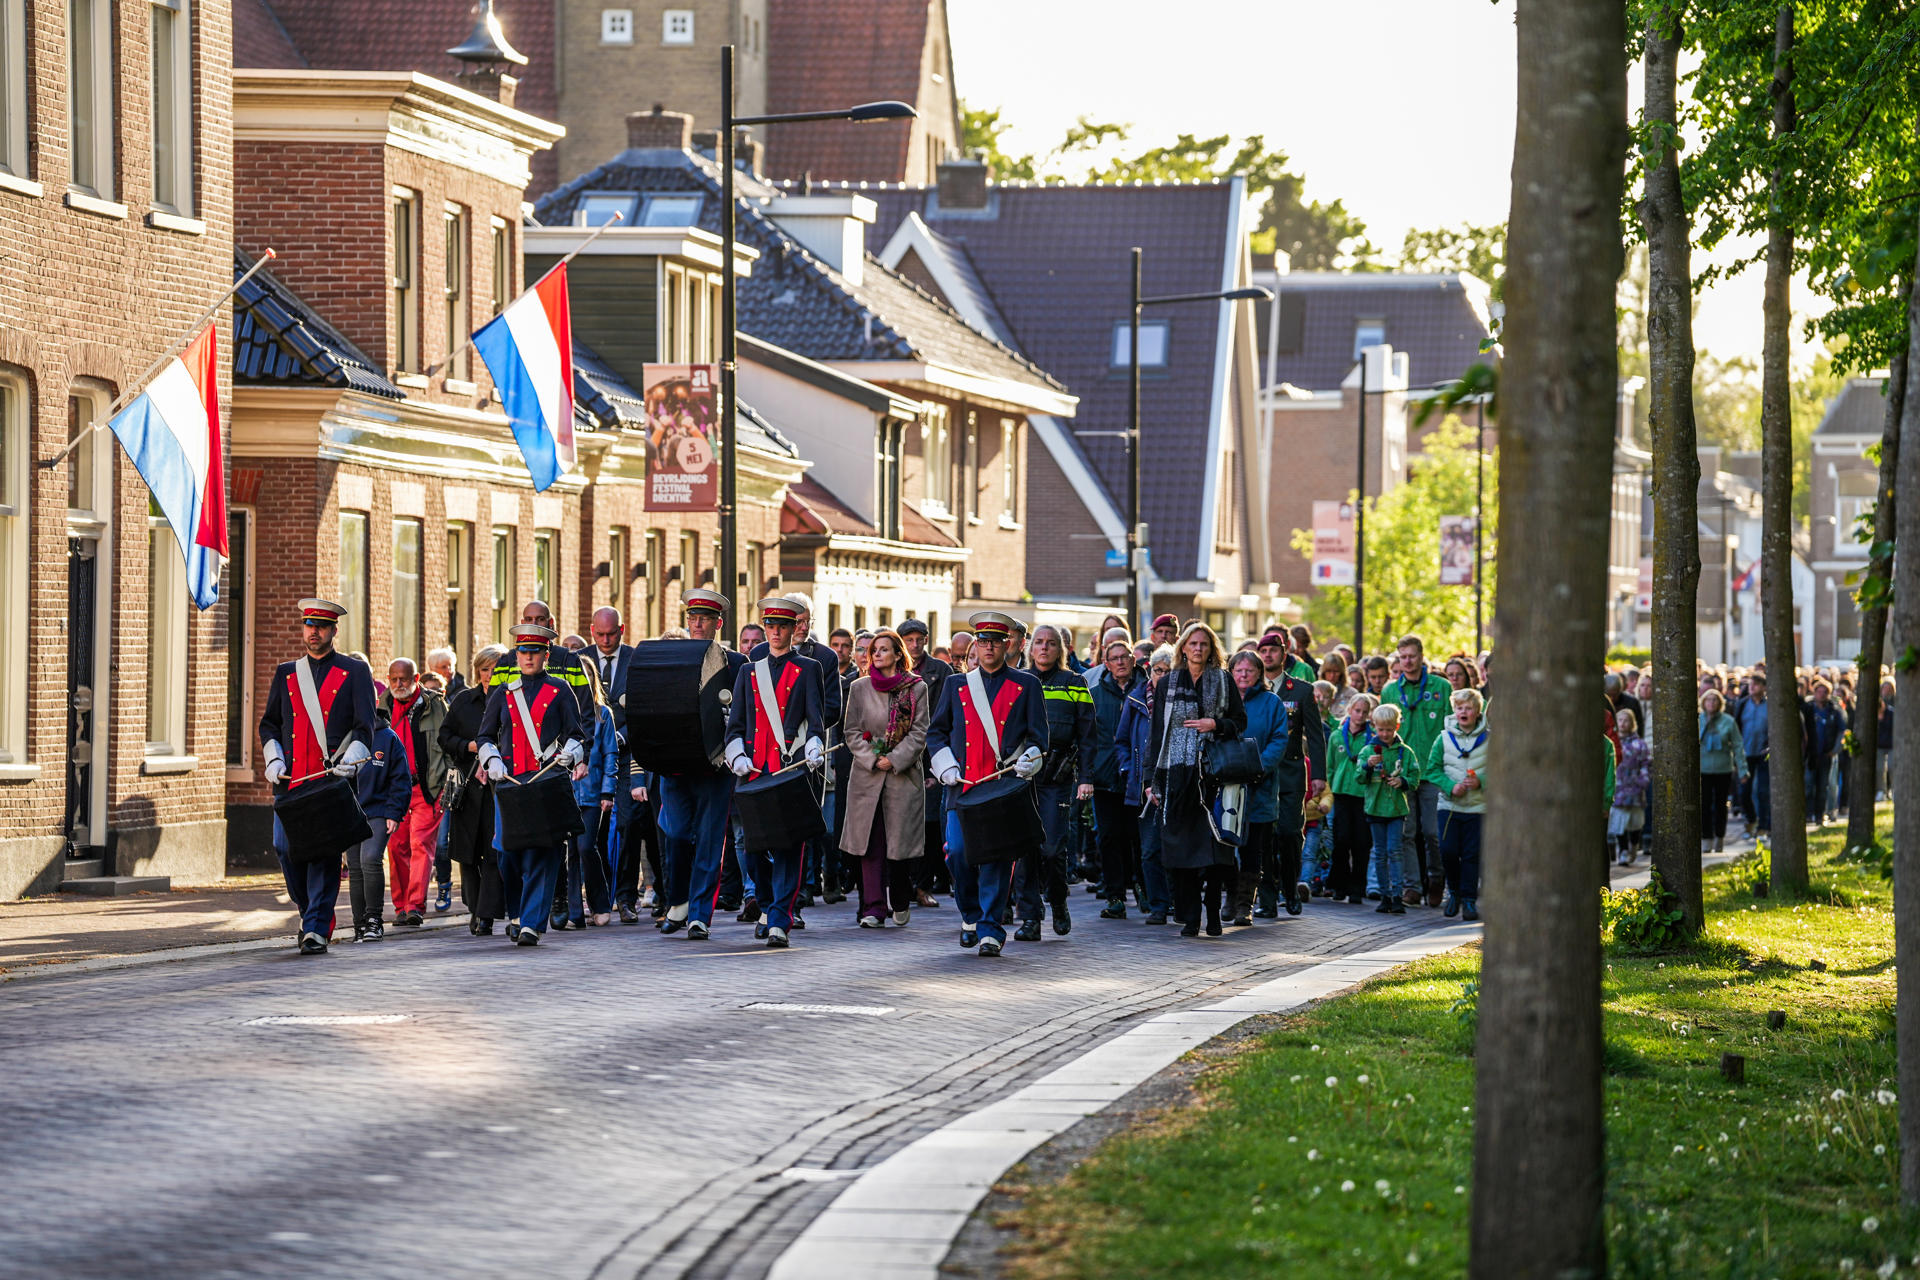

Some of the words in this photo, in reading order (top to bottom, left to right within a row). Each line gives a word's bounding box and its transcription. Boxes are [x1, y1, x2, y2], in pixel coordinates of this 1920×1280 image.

[692, 370, 709, 386] a
[689, 443, 696, 452] 5
[686, 453, 703, 464] MEI
[653, 473, 709, 484] BEVRIJDINGS
[653, 484, 693, 493] FESTIVAL
[653, 494, 692, 503] DRENTHE
